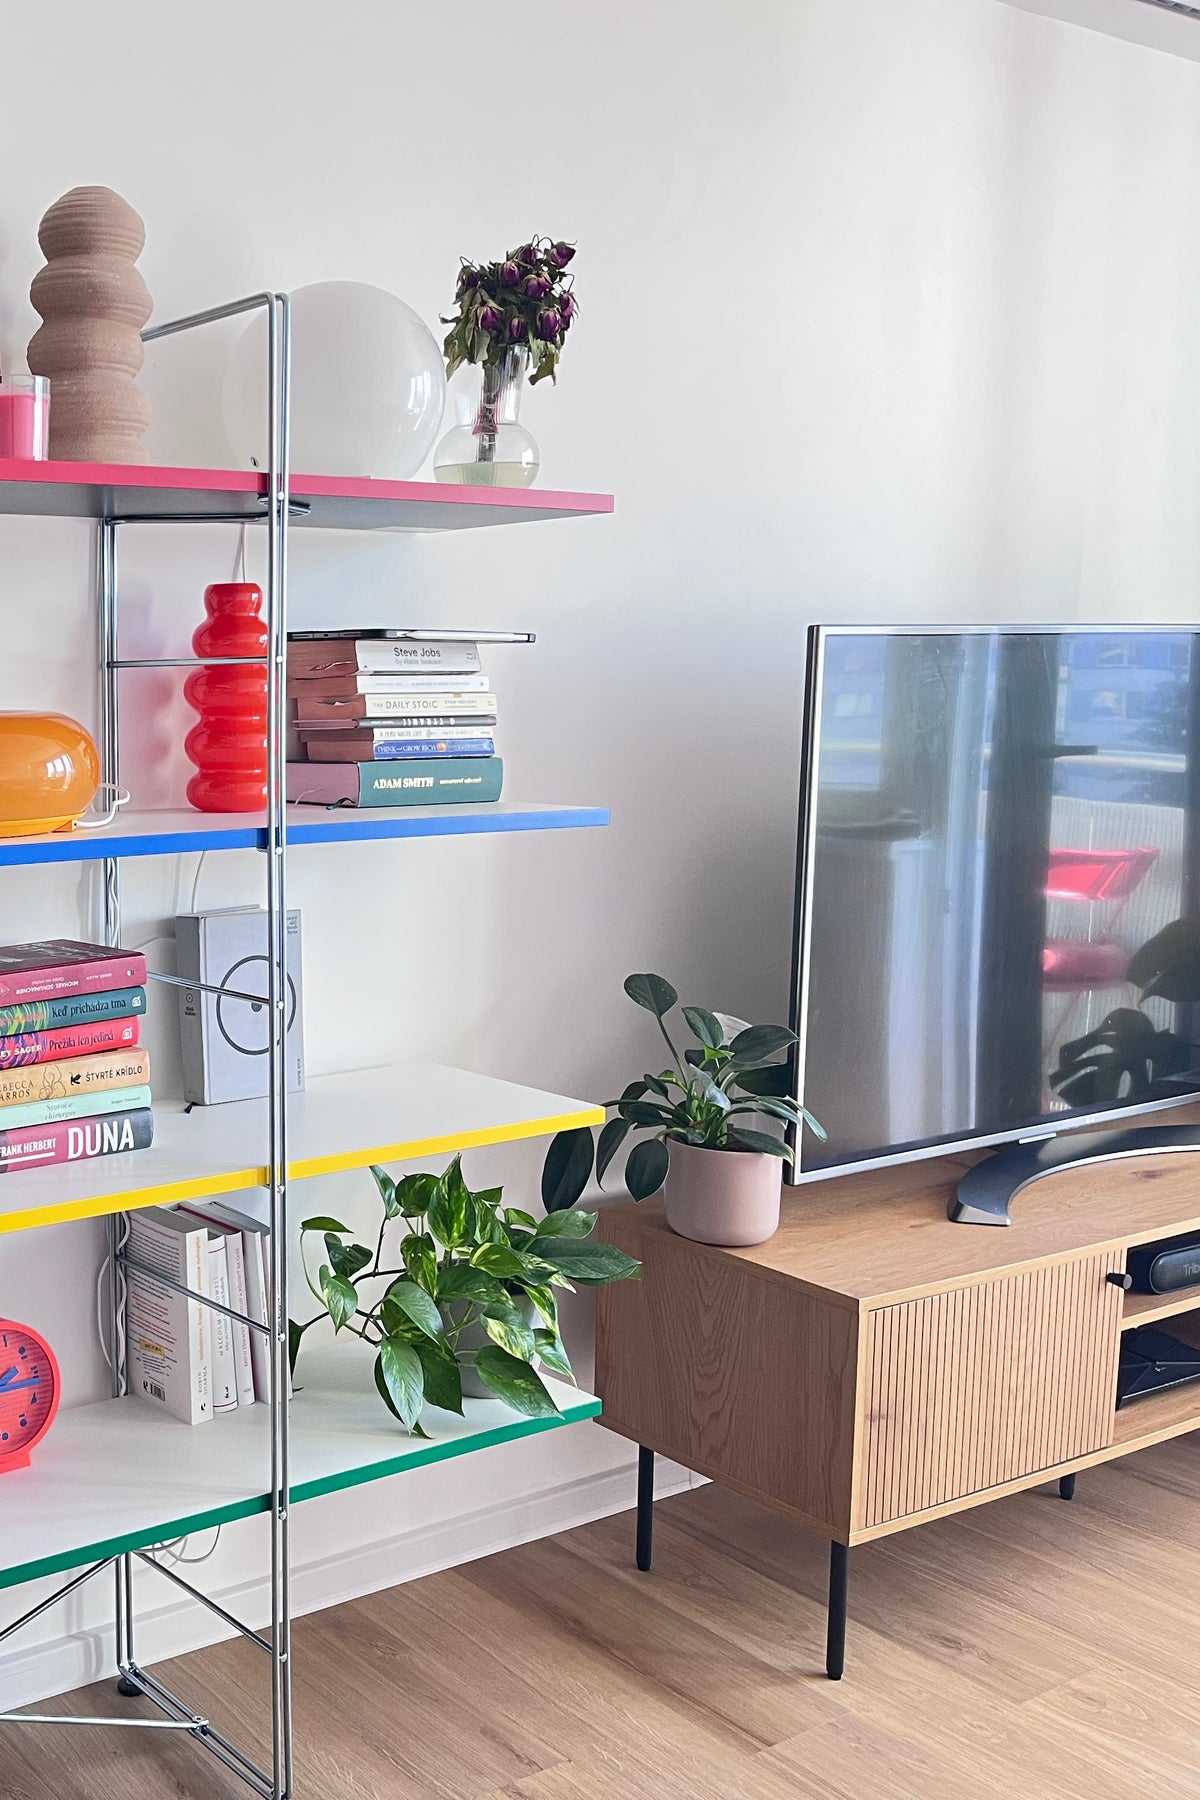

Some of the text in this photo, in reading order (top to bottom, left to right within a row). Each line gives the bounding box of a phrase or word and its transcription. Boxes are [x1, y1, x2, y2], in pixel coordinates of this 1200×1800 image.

[393, 646, 441, 657] Steve Jobs
[385, 700, 410, 709] DAILY
[411, 700, 438, 709] STOIC
[377, 745, 396, 753] THINK
[373, 778, 401, 789] ADAM
[403, 777, 434, 788] SMITH
[15, 980, 79, 995] MICHAEL SCHUMACHER
[70, 1001, 109, 1016] prichádza
[110, 999, 126, 1009] tma
[50, 1030, 114, 1051] Prežila len jediná
[14, 1044, 42, 1054] SAGER
[85, 1065, 143, 1082] ŠTVRTÉ KRÍDLO
[23, 1138, 57, 1153] HERBERT
[67, 1119, 134, 1159] DUNA
[216, 1319, 224, 1356] MALCOLM
